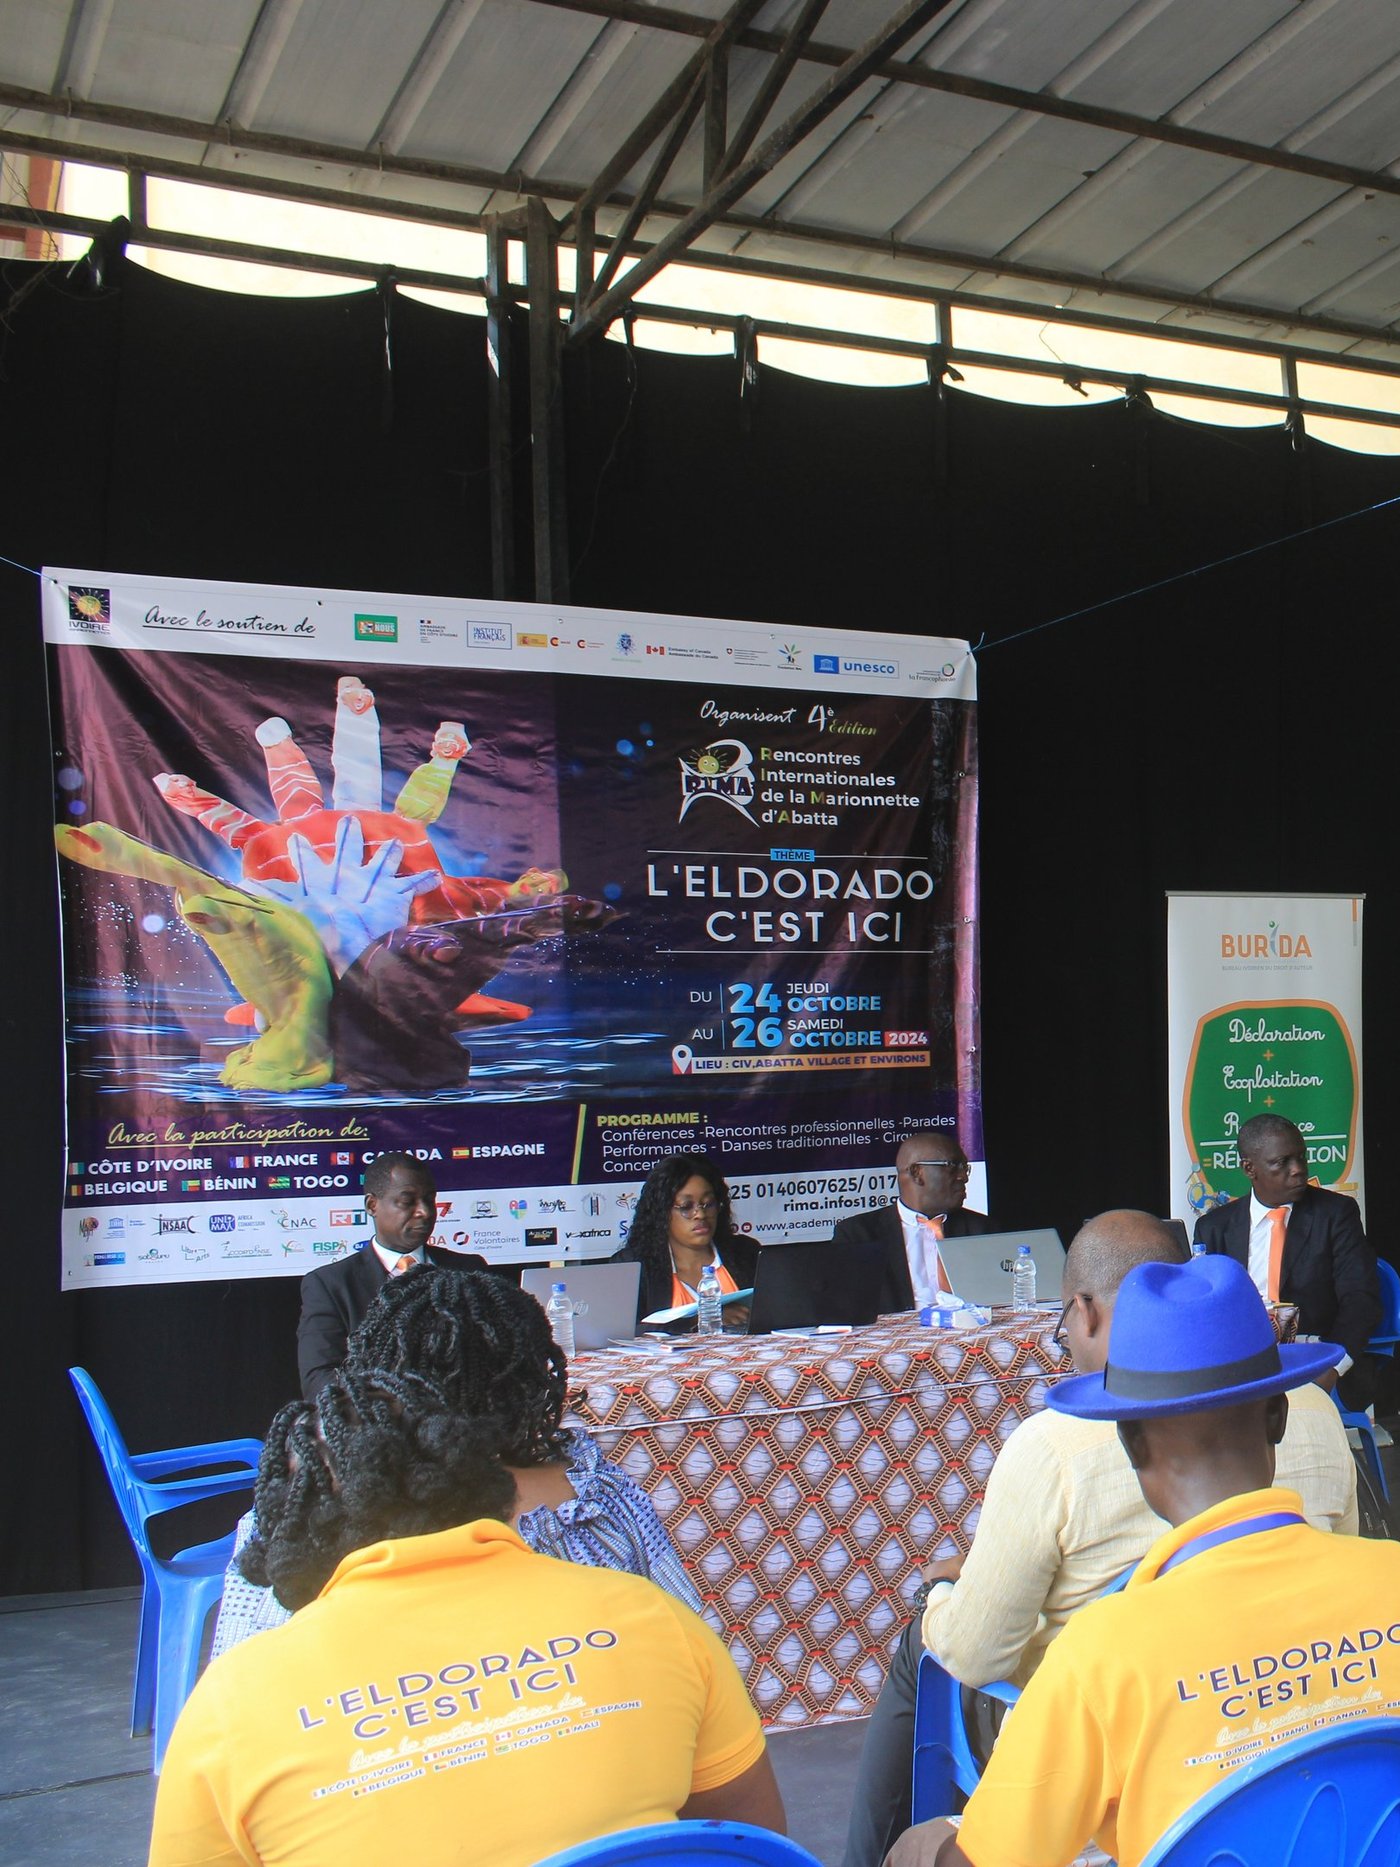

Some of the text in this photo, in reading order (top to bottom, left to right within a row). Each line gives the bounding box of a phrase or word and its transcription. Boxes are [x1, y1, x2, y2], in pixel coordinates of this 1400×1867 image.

[145, 605, 317, 634] Avec le soutien de
[473, 627, 503, 635] INSTITUT
[843, 662, 895, 674] unesco
[700, 700, 797, 727] Organisent
[760, 747, 861, 766] Rencontres
[760, 768, 896, 787] Internationales
[761, 789, 920, 808] de la Marionnette
[648, 864, 933, 900] L'ELDORADO
[706, 910, 901, 943] C'EST ICI
[1221, 921, 1313, 958] BURIDA
[787, 983, 829, 994] JEUDI
[690, 991, 712, 1003] DU
[728, 983, 782, 1014] 24
[787, 996, 881, 1012] OCTOBRE
[731, 1016, 784, 1048] 26
[787, 1018, 844, 1030] SAMEDI
[1229, 1018, 1325, 1043] Déclaration
[692, 1029, 713, 1040] AU
[789, 1031, 928, 1047] OCTOBRE 2024
[696, 1060, 722, 1069] LIEU
[807, 1056, 852, 1065] VILLAGE
[854, 1055, 866, 1064] ET
[870, 1054, 926, 1064] ENVIRONS
[1222, 1065, 1323, 1102] Exploitation
[597, 1113, 700, 1127] PROGRAMME
[108, 1122, 157, 1145] Avec
[164, 1122, 184, 1143] la
[189, 1121, 333, 1149] participation
[602, 1128, 695, 1142] Conférences
[791, 1118, 895, 1136] professionnelles
[472, 1143, 545, 1158] ESPAGNE
[603, 1143, 707, 1158] Performances
[721, 1139, 773, 1152] Danses
[777, 1133, 871, 1149] traditionnelles
[254, 1153, 318, 1168] FRANCE
[362, 1148, 443, 1164] CDA
[88, 1159, 135, 1175] CÔTE
[603, 1159, 660, 1173] Concer
[84, 1179, 168, 1196] BELGIQUE
[204, 1176, 257, 1191] BÉNIN
[294, 1175, 349, 1189] TOGO
[282, 1218, 317, 1229] CNAC
[473, 1236, 520, 1245] Volontaires
[299, 1629, 618, 1729] L'ELDORADO
[1221, 1658, 1377, 1718] C'EST ICI
[353, 1662, 577, 1739] C'EST ICI
[594, 1701, 641, 1715] ESPAGNE
[1329, 1708, 1368, 1722] CANADA
[516, 1716, 570, 1736] CANADA
[573, 1721, 600, 1734] MALI
[1282, 1724, 1310, 1740] FRANCE
[441, 1740, 486, 1757] FRANCE
[512, 1734, 550, 1750] TOGO
[450, 1752, 487, 1768] BÉNIN
[1199, 1752, 1222, 1763] CÔTE
[328, 1776, 358, 1794] CÔTE
[368, 1770, 425, 1793] BELGIQUE
